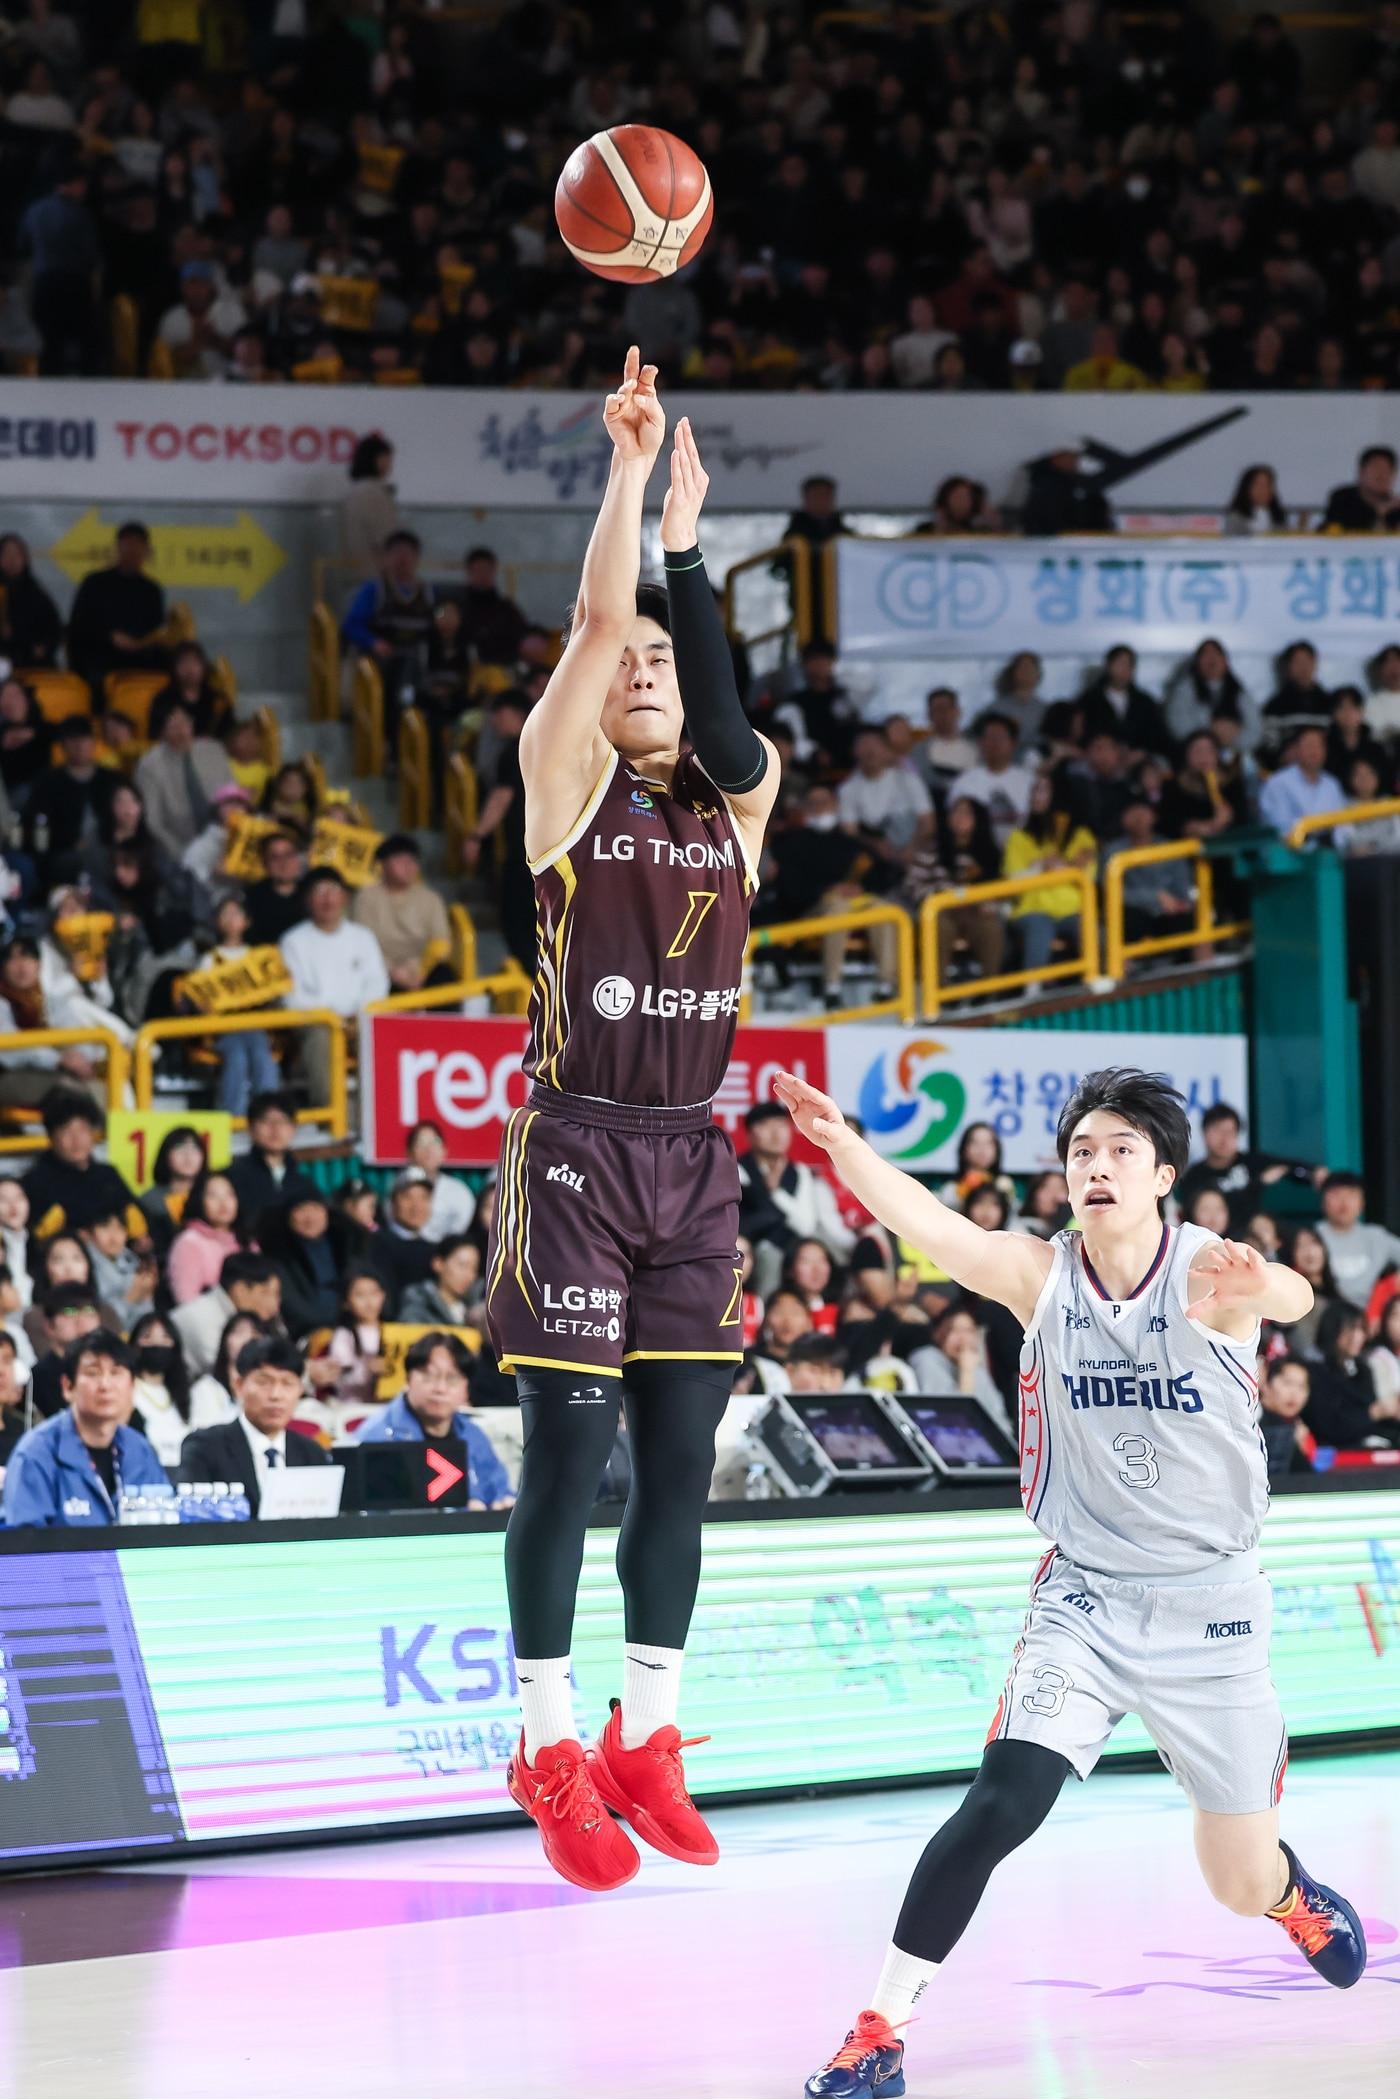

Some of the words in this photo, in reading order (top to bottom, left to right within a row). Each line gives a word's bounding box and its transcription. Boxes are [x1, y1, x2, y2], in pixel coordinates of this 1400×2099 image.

[116, 420, 384, 464] TOCKSOD
[1030, 557, 1248, 626] 상화(주)
[1282, 557, 1400, 622] 상화
[593, 834, 635, 861] LG
[666, 891, 718, 958] 7
[546, 1164, 586, 1192] KBL
[543, 1284, 622, 1315] LG화학
[1112, 1305, 1121, 1318] P
[1079, 1359, 1130, 1370] HYUNDAI
[1133, 1362, 1157, 1374] BIS
[1113, 1432, 1160, 1489] 3
[1062, 1592, 1096, 1616] KBL
[1204, 1620, 1253, 1639] Motta
[1022, 1664, 1074, 1718] 3
